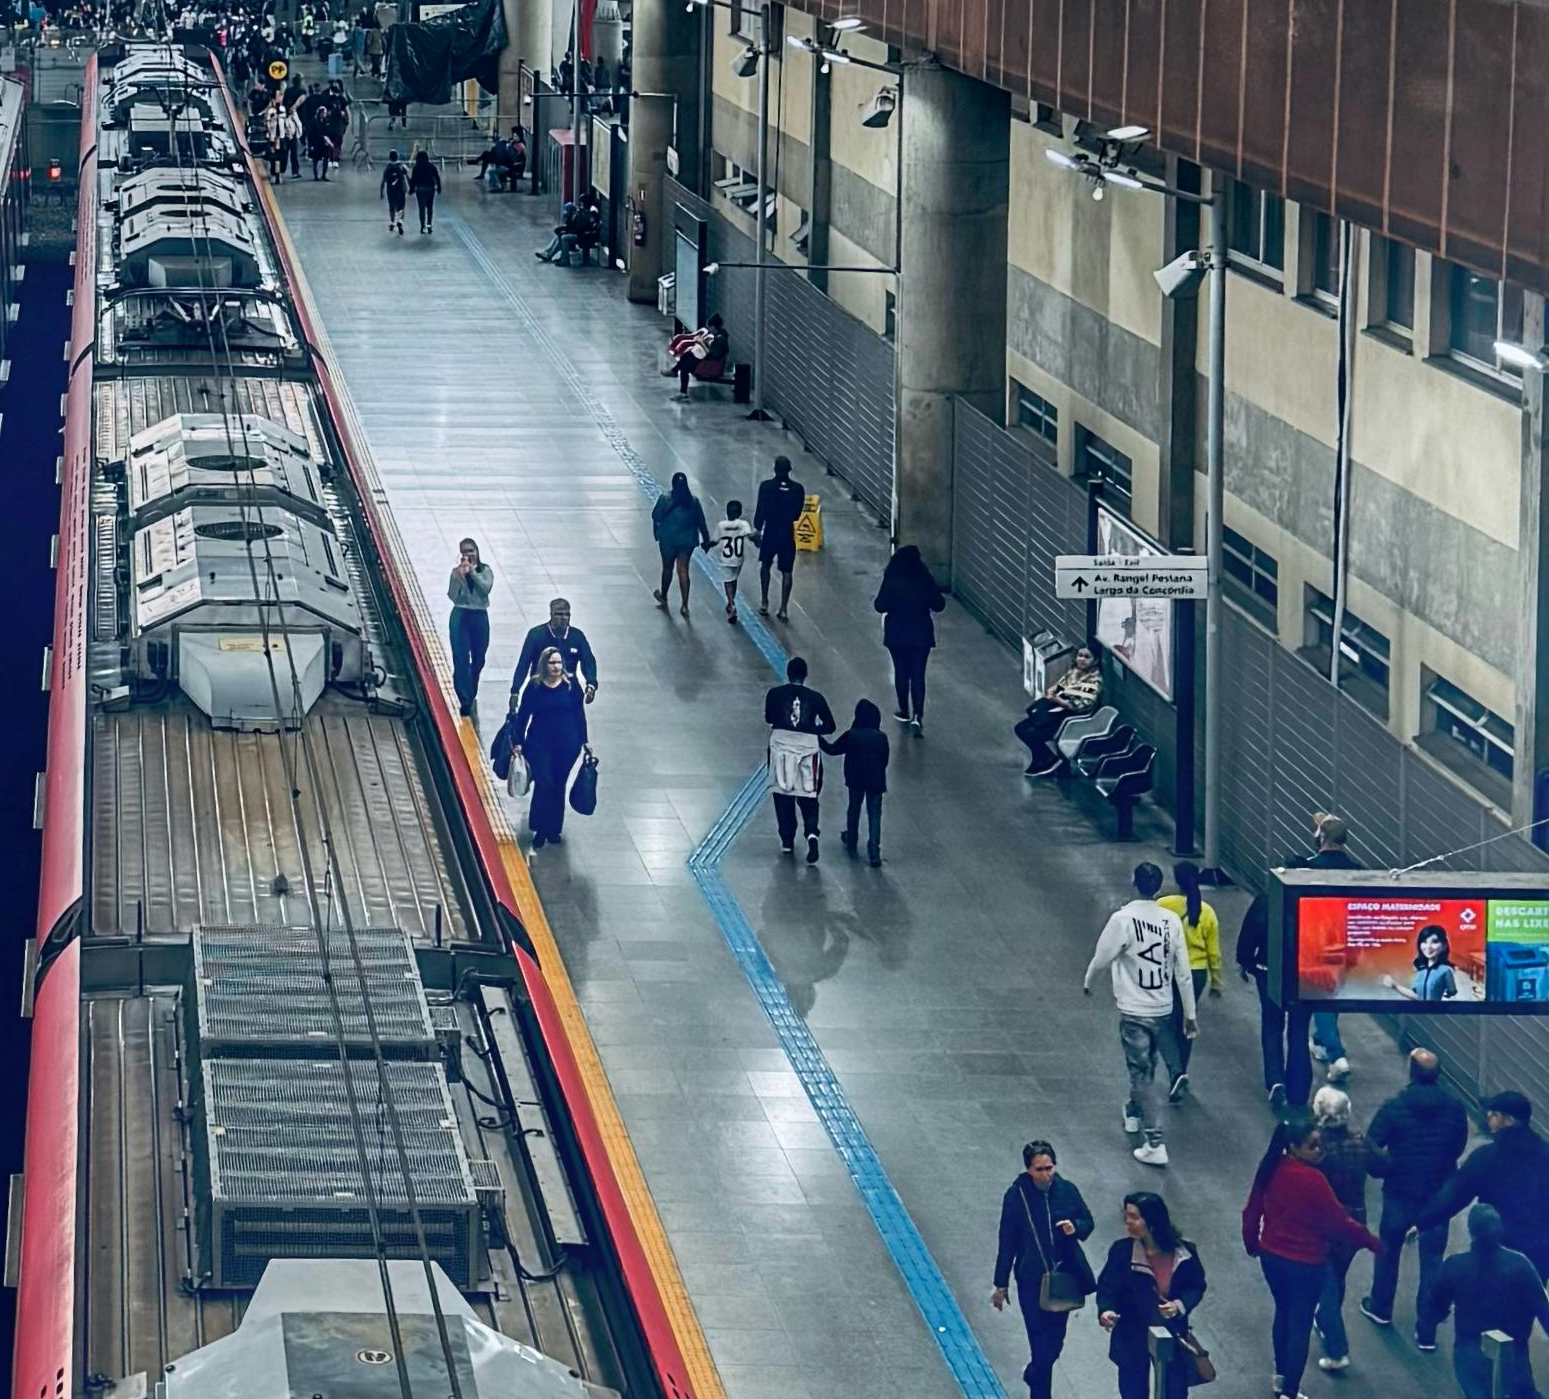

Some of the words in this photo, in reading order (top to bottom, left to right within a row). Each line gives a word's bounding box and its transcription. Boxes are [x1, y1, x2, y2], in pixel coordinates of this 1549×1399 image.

[721, 535, 745, 559] 30
[1114, 573, 1149, 585] Rangel
[1152, 573, 1193, 583] Pestana
